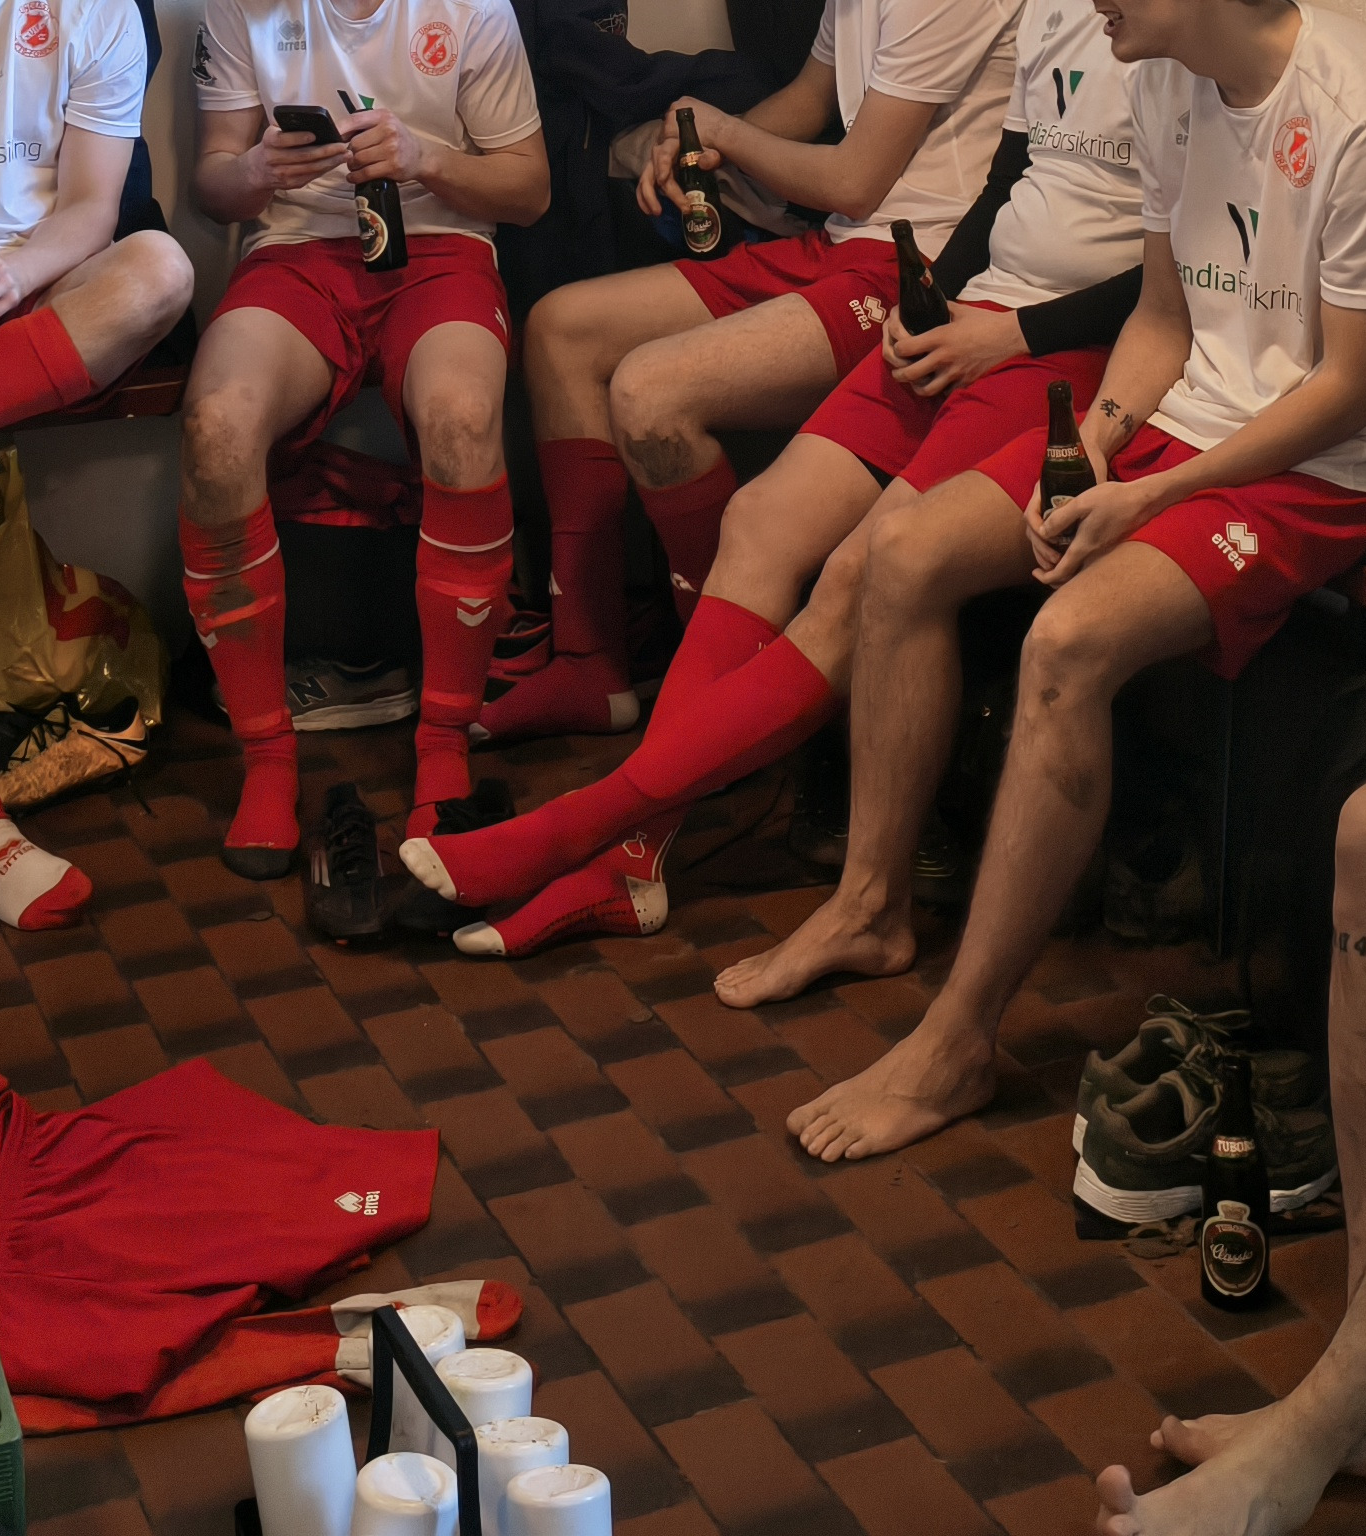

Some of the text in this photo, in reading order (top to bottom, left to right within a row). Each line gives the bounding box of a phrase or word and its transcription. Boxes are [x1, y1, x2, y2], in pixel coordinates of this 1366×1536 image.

[849, 299, 872, 331] errea
[1047, 447, 1079, 458] TUBORG
[1211, 533, 1246, 572] errea
